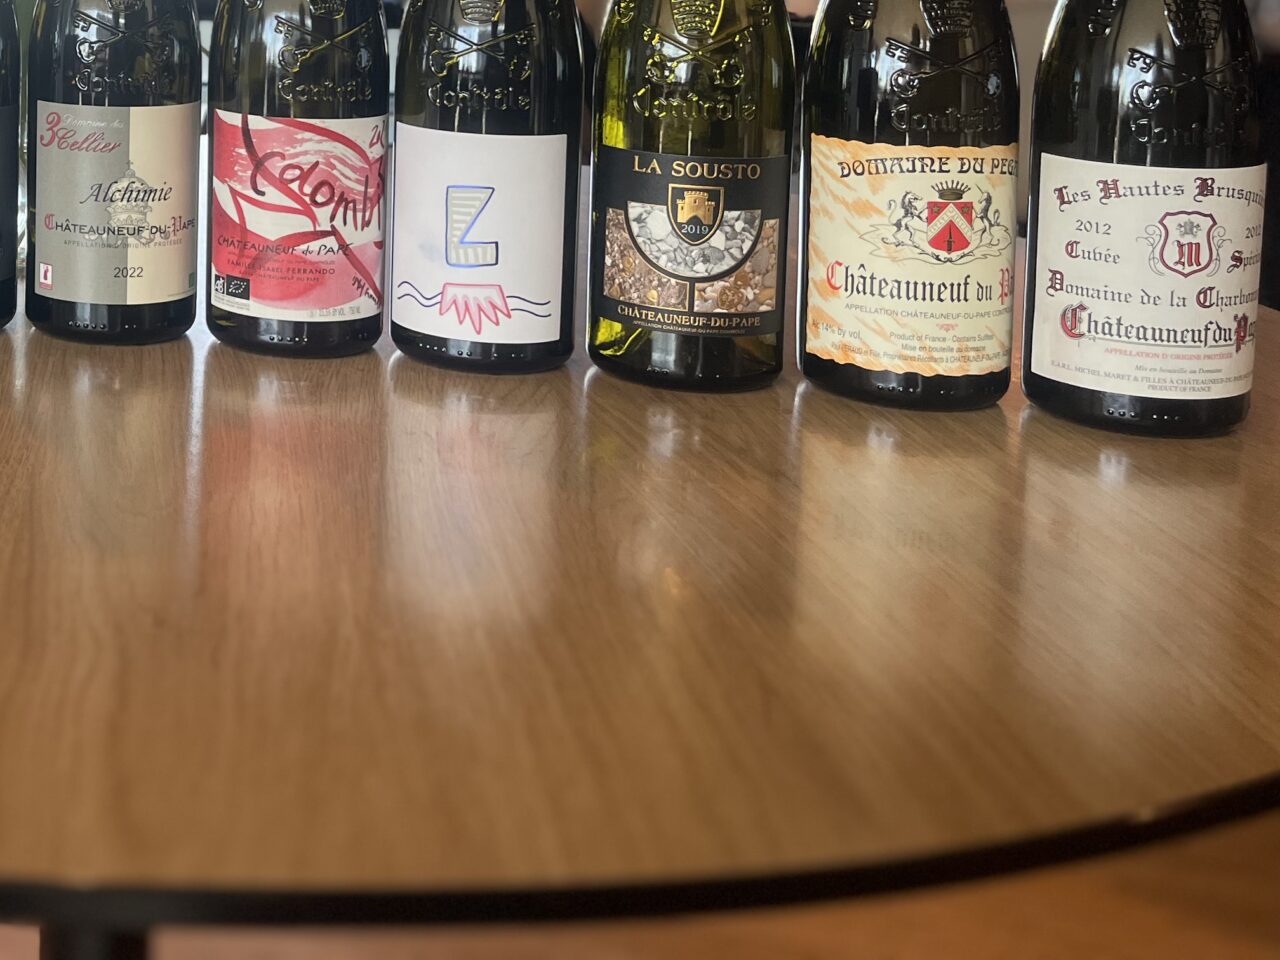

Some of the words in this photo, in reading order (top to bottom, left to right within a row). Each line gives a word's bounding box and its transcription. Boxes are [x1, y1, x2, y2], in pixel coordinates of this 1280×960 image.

[40, 111, 62, 148] 3
[55, 127, 123, 154] Cellier
[633, 155, 662, 175] LA
[671, 160, 761, 180] SOUSTO
[838, 157, 952, 178] DOMAINE
[957, 157, 985, 175] DU
[79, 181, 173, 205] Alchimie
[1054, 186, 1091, 212] Les
[1096, 178, 1185, 206] Hautes
[44, 213, 196, 237] CHÂTEAUNEUF-DU-PAPE
[681, 224, 709, 235] 2019
[1075, 219, 1112, 236] 2012
[302, 245, 314, 256] du
[1065, 240, 1120, 265] Cuvée
[113, 267, 144, 279] 2022
[286, 267, 336, 276] FERRANDO
[826, 260, 972, 303] Châteauneuf
[976, 281, 993, 303] du
[1046, 268, 1133, 304] Domaine
[1139, 289, 1161, 307] de
[1170, 290, 1188, 308] la
[617, 304, 761, 328] CHÂTEAUNEUF-DU-PAPE
[844, 303, 899, 317] APPELLATION
[889, 331, 916, 342] Product
[1213, 321, 1234, 344] du
